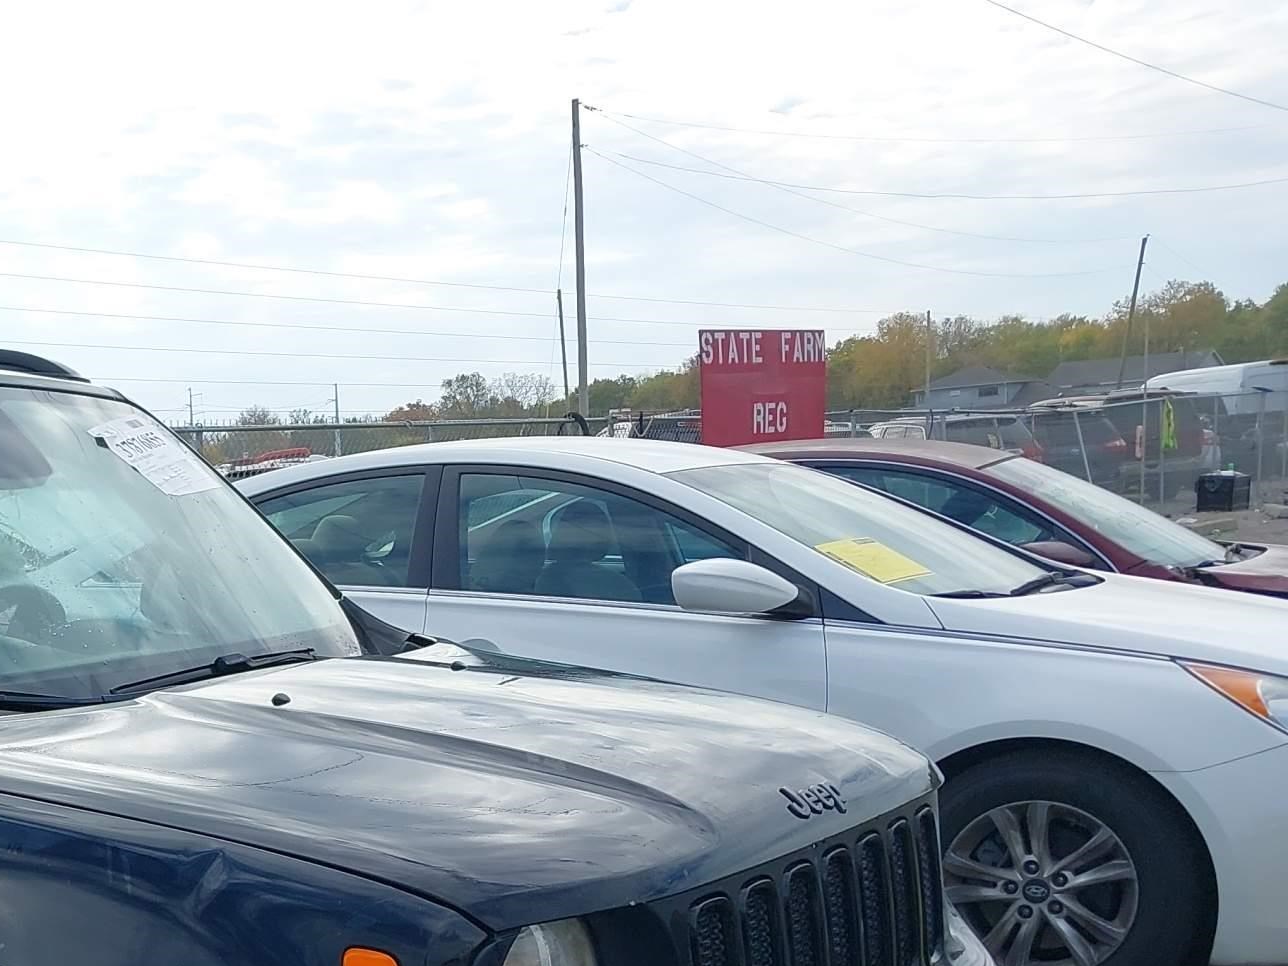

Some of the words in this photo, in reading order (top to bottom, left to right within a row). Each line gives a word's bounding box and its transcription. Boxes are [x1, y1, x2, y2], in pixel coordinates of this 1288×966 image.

[700, 332, 763, 364] STATE
[781, 331, 825, 363] FARM
[778, 783, 848, 820] Jeep
